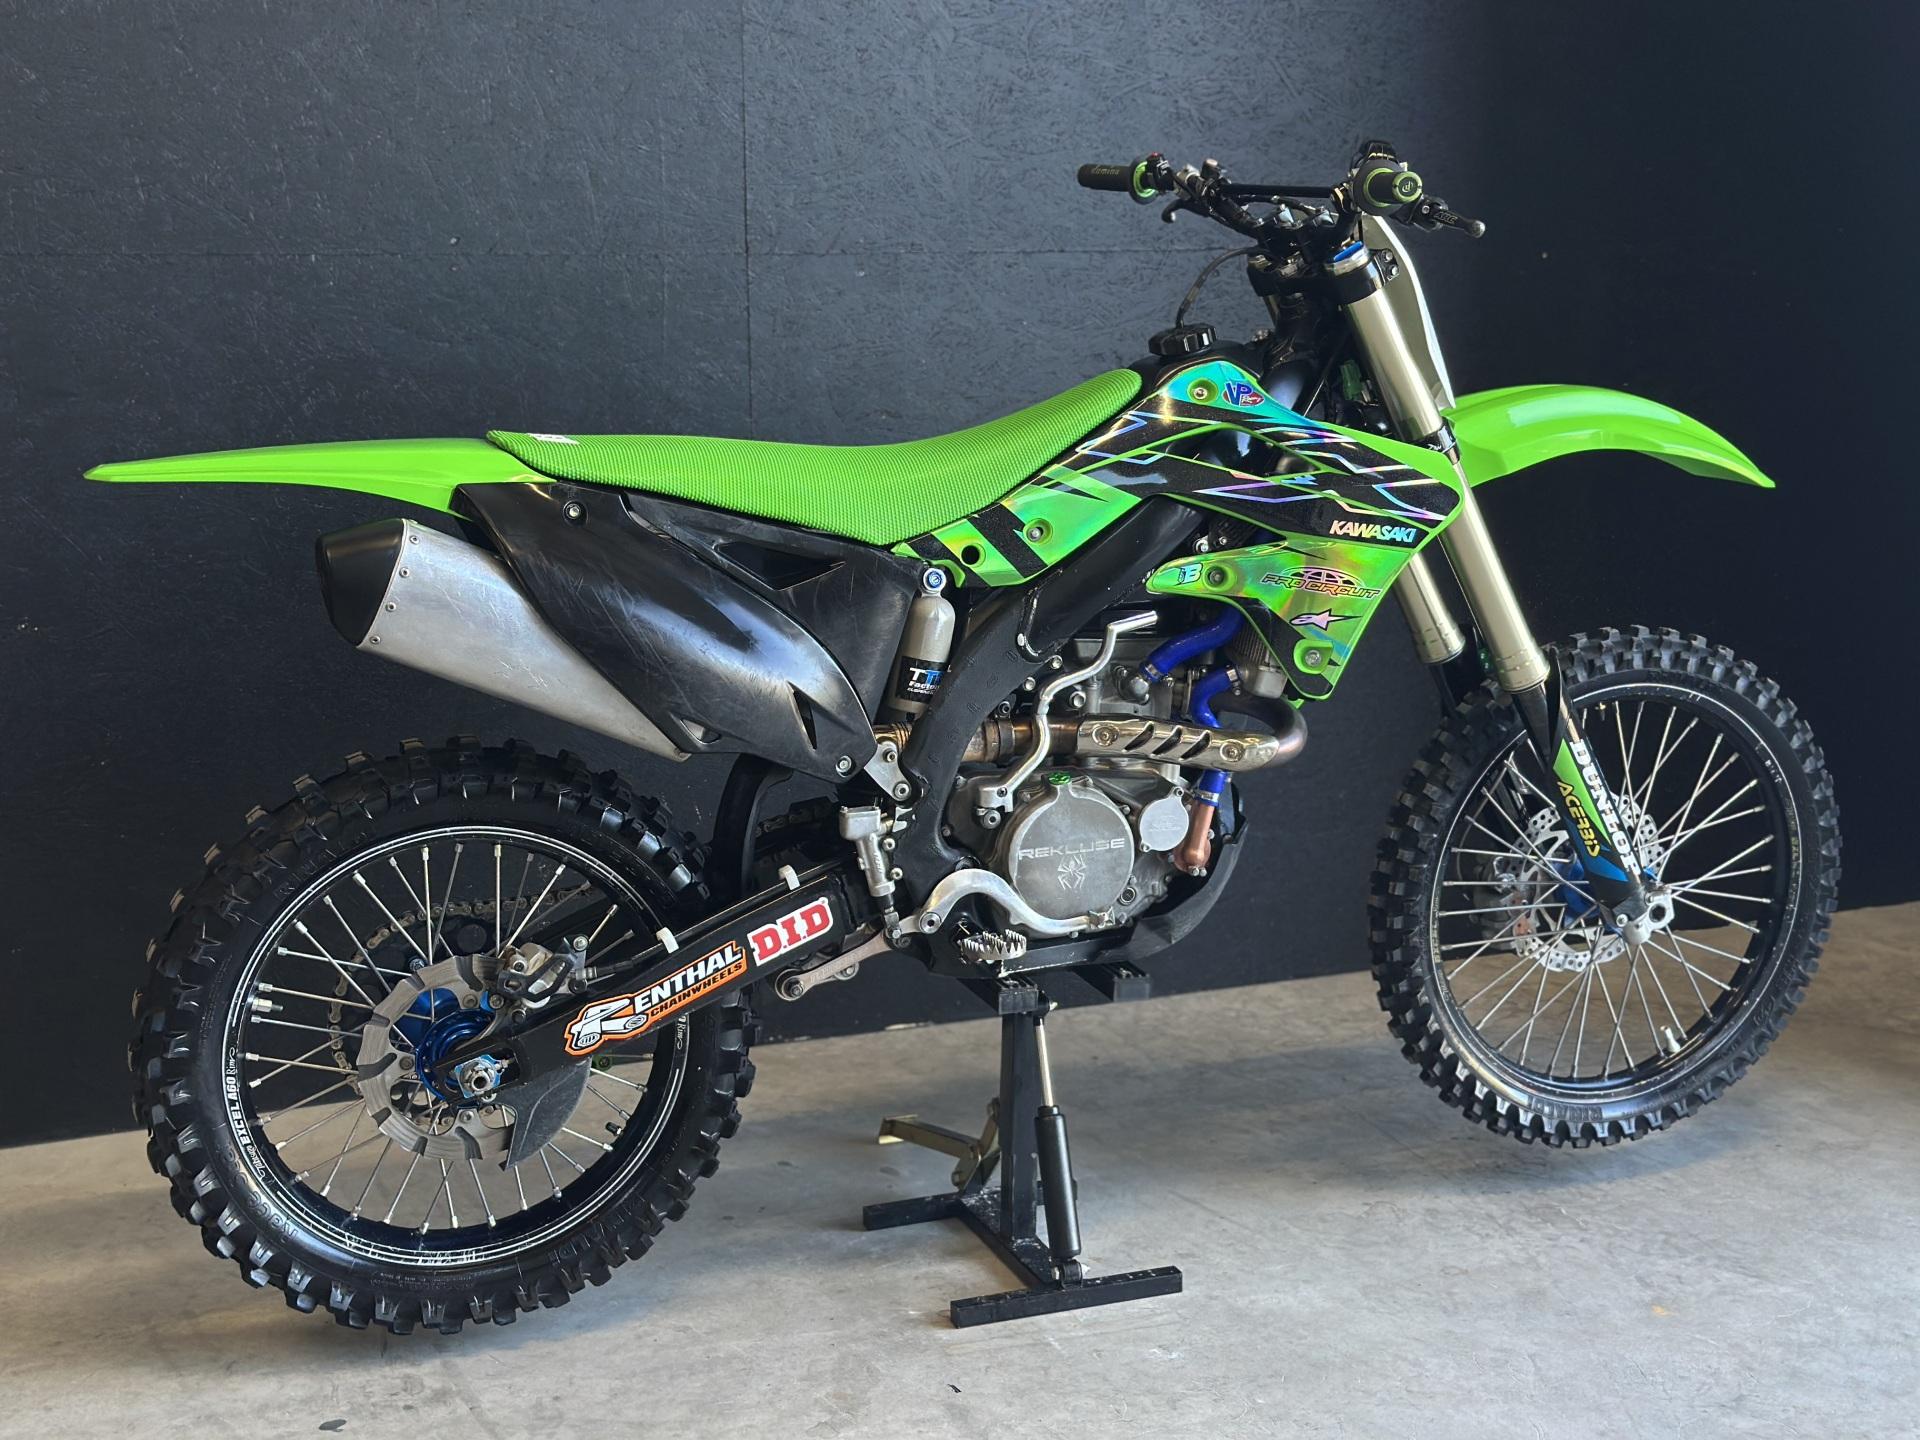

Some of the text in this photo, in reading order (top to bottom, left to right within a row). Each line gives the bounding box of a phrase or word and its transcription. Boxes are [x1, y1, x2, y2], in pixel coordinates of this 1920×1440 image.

[1224, 381, 1253, 406] VP
[1329, 520, 1417, 543] KAWASAKI
[1261, 573, 1381, 599] PRO CIRCUIT
[1569, 738, 1641, 876] DUNLOP
[1018, 837, 1126, 861] REKLUSE
[752, 902, 831, 961] D.I.D
[649, 960, 744, 1018] CHAINWHEELS
[226, 1076, 238, 1099] A60
[231, 1101, 251, 1144] EXCEL
